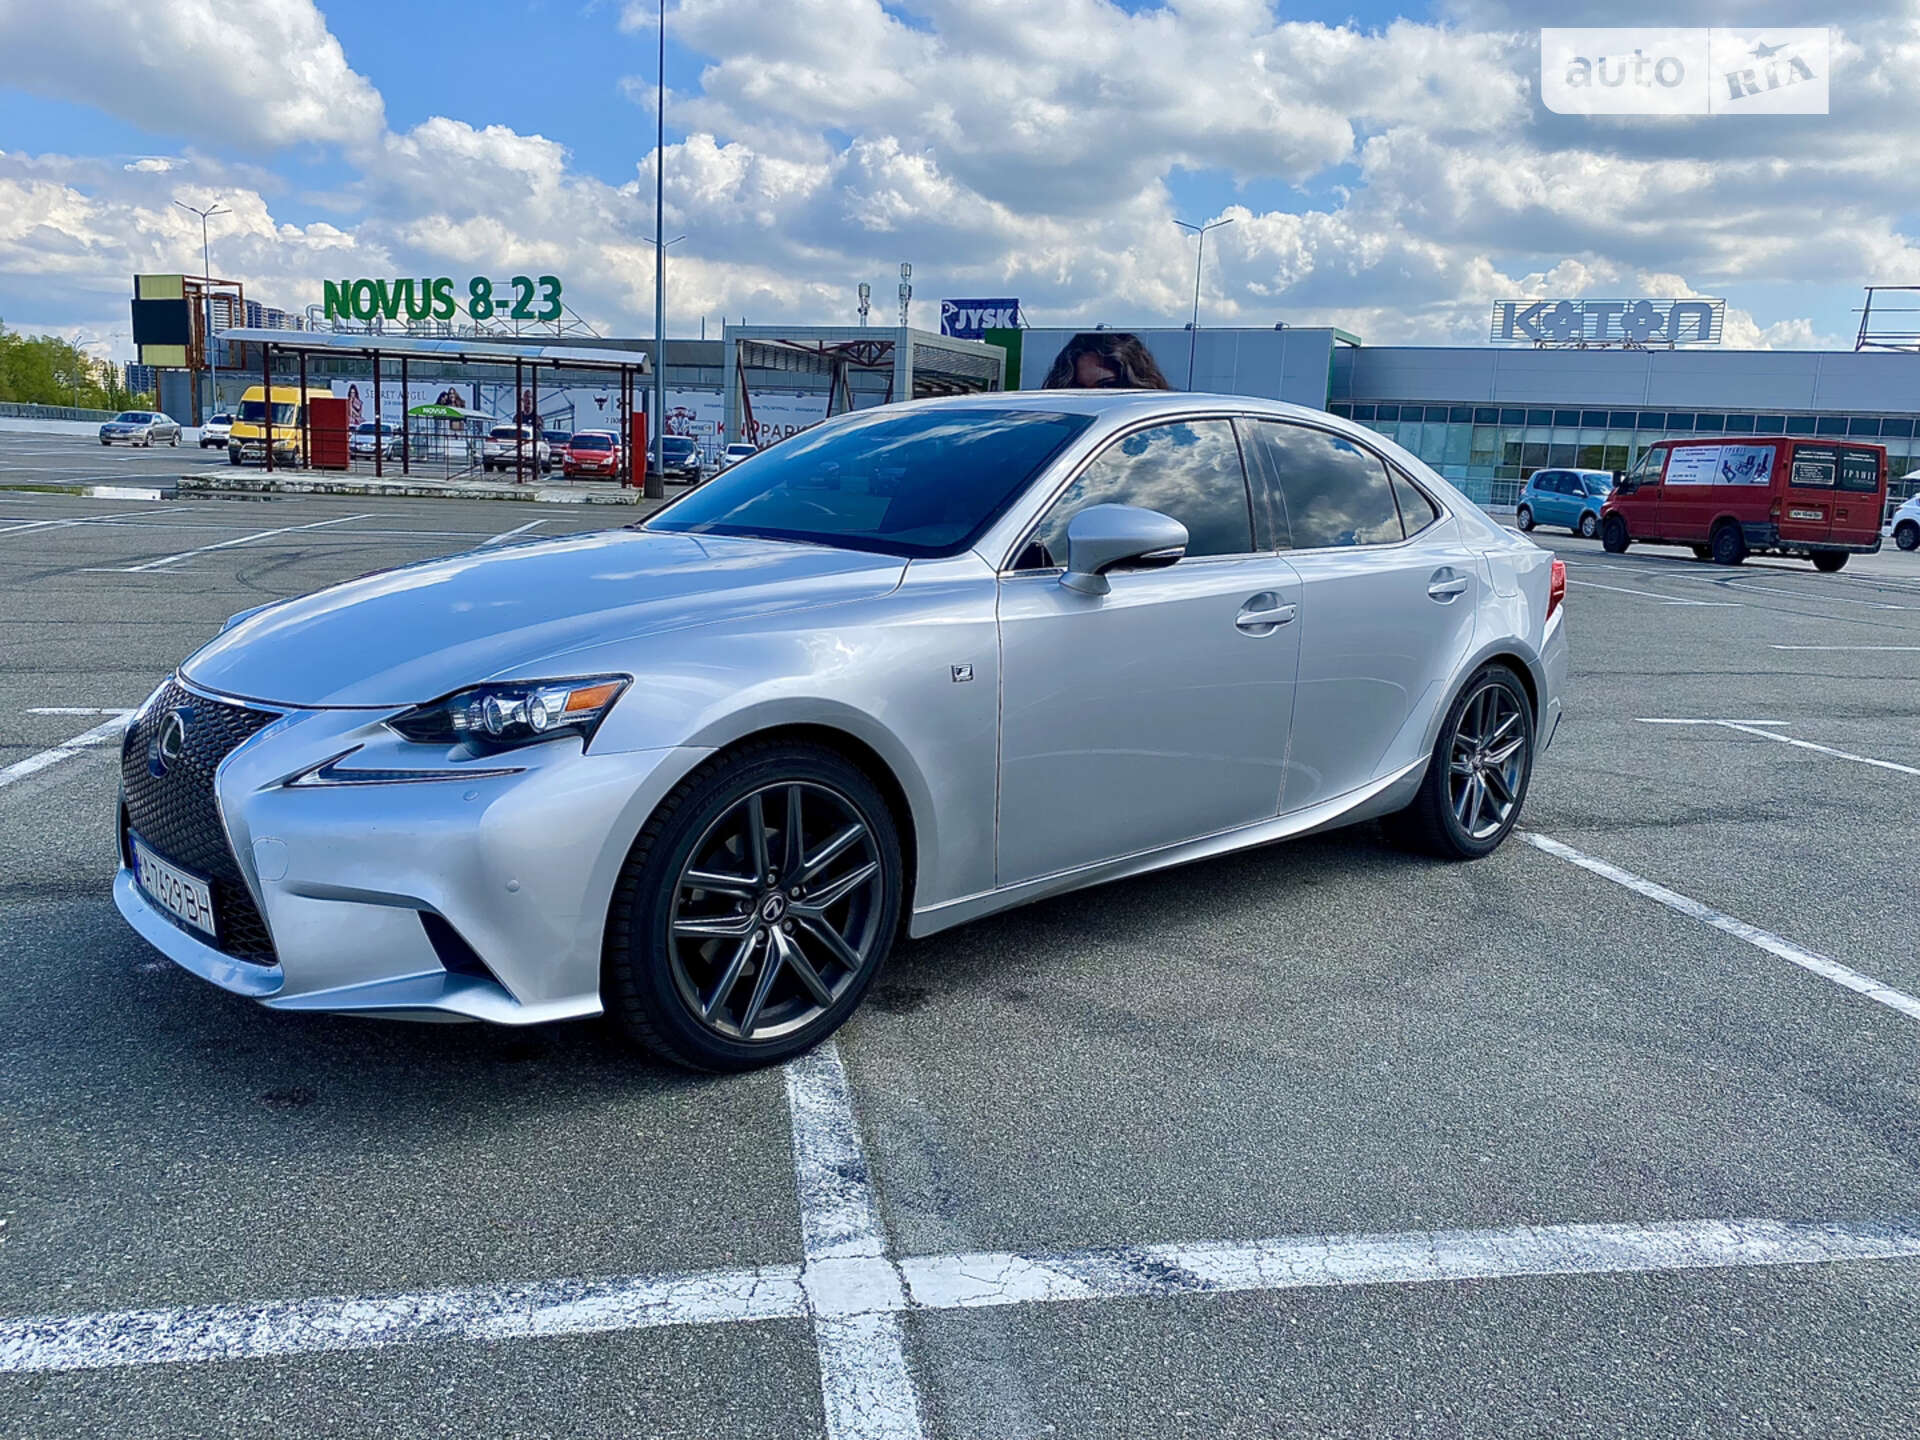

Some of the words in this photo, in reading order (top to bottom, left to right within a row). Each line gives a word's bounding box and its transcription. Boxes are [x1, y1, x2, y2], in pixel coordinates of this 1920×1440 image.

[324, 278, 456, 320] NOVUS
[469, 276, 562, 321] 8-23
[955, 308, 1014, 329] JYSK
[365, 389, 396, 400] SERET
[397, 390, 427, 401] AGEL
[423, 407, 448, 416] NOVUS
